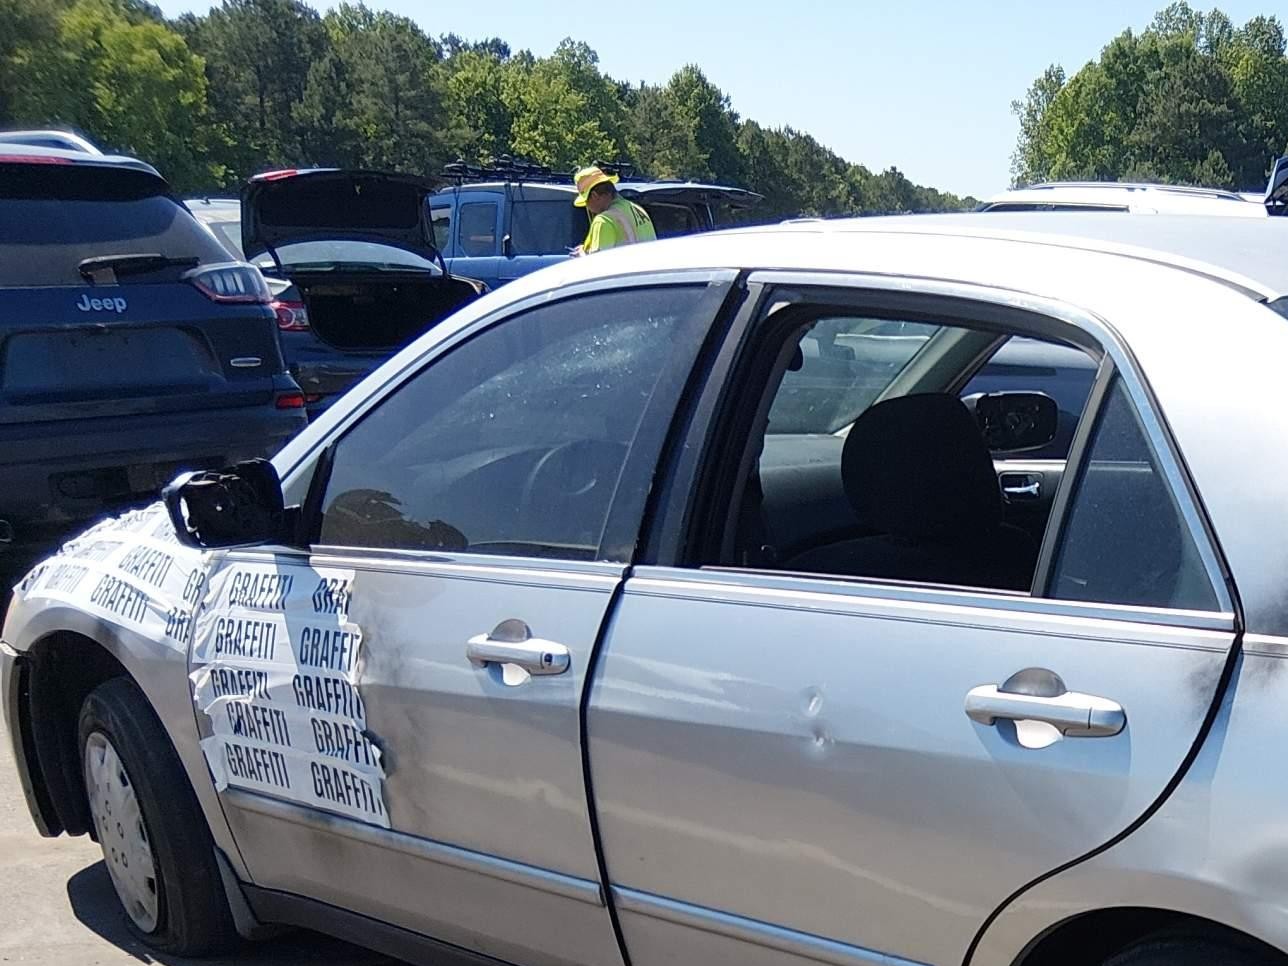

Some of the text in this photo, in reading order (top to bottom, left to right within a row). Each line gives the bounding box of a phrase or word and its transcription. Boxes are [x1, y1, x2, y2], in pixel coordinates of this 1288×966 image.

[77, 294, 127, 313] Jeep
[90, 573, 150, 624] GRAFFITI
[229, 572, 294, 611] GRAFFITI
[215, 618, 277, 661] GRAFFITI
[226, 702, 291, 747] GRAFFITI
[225, 742, 290, 789] GRAFFITI
